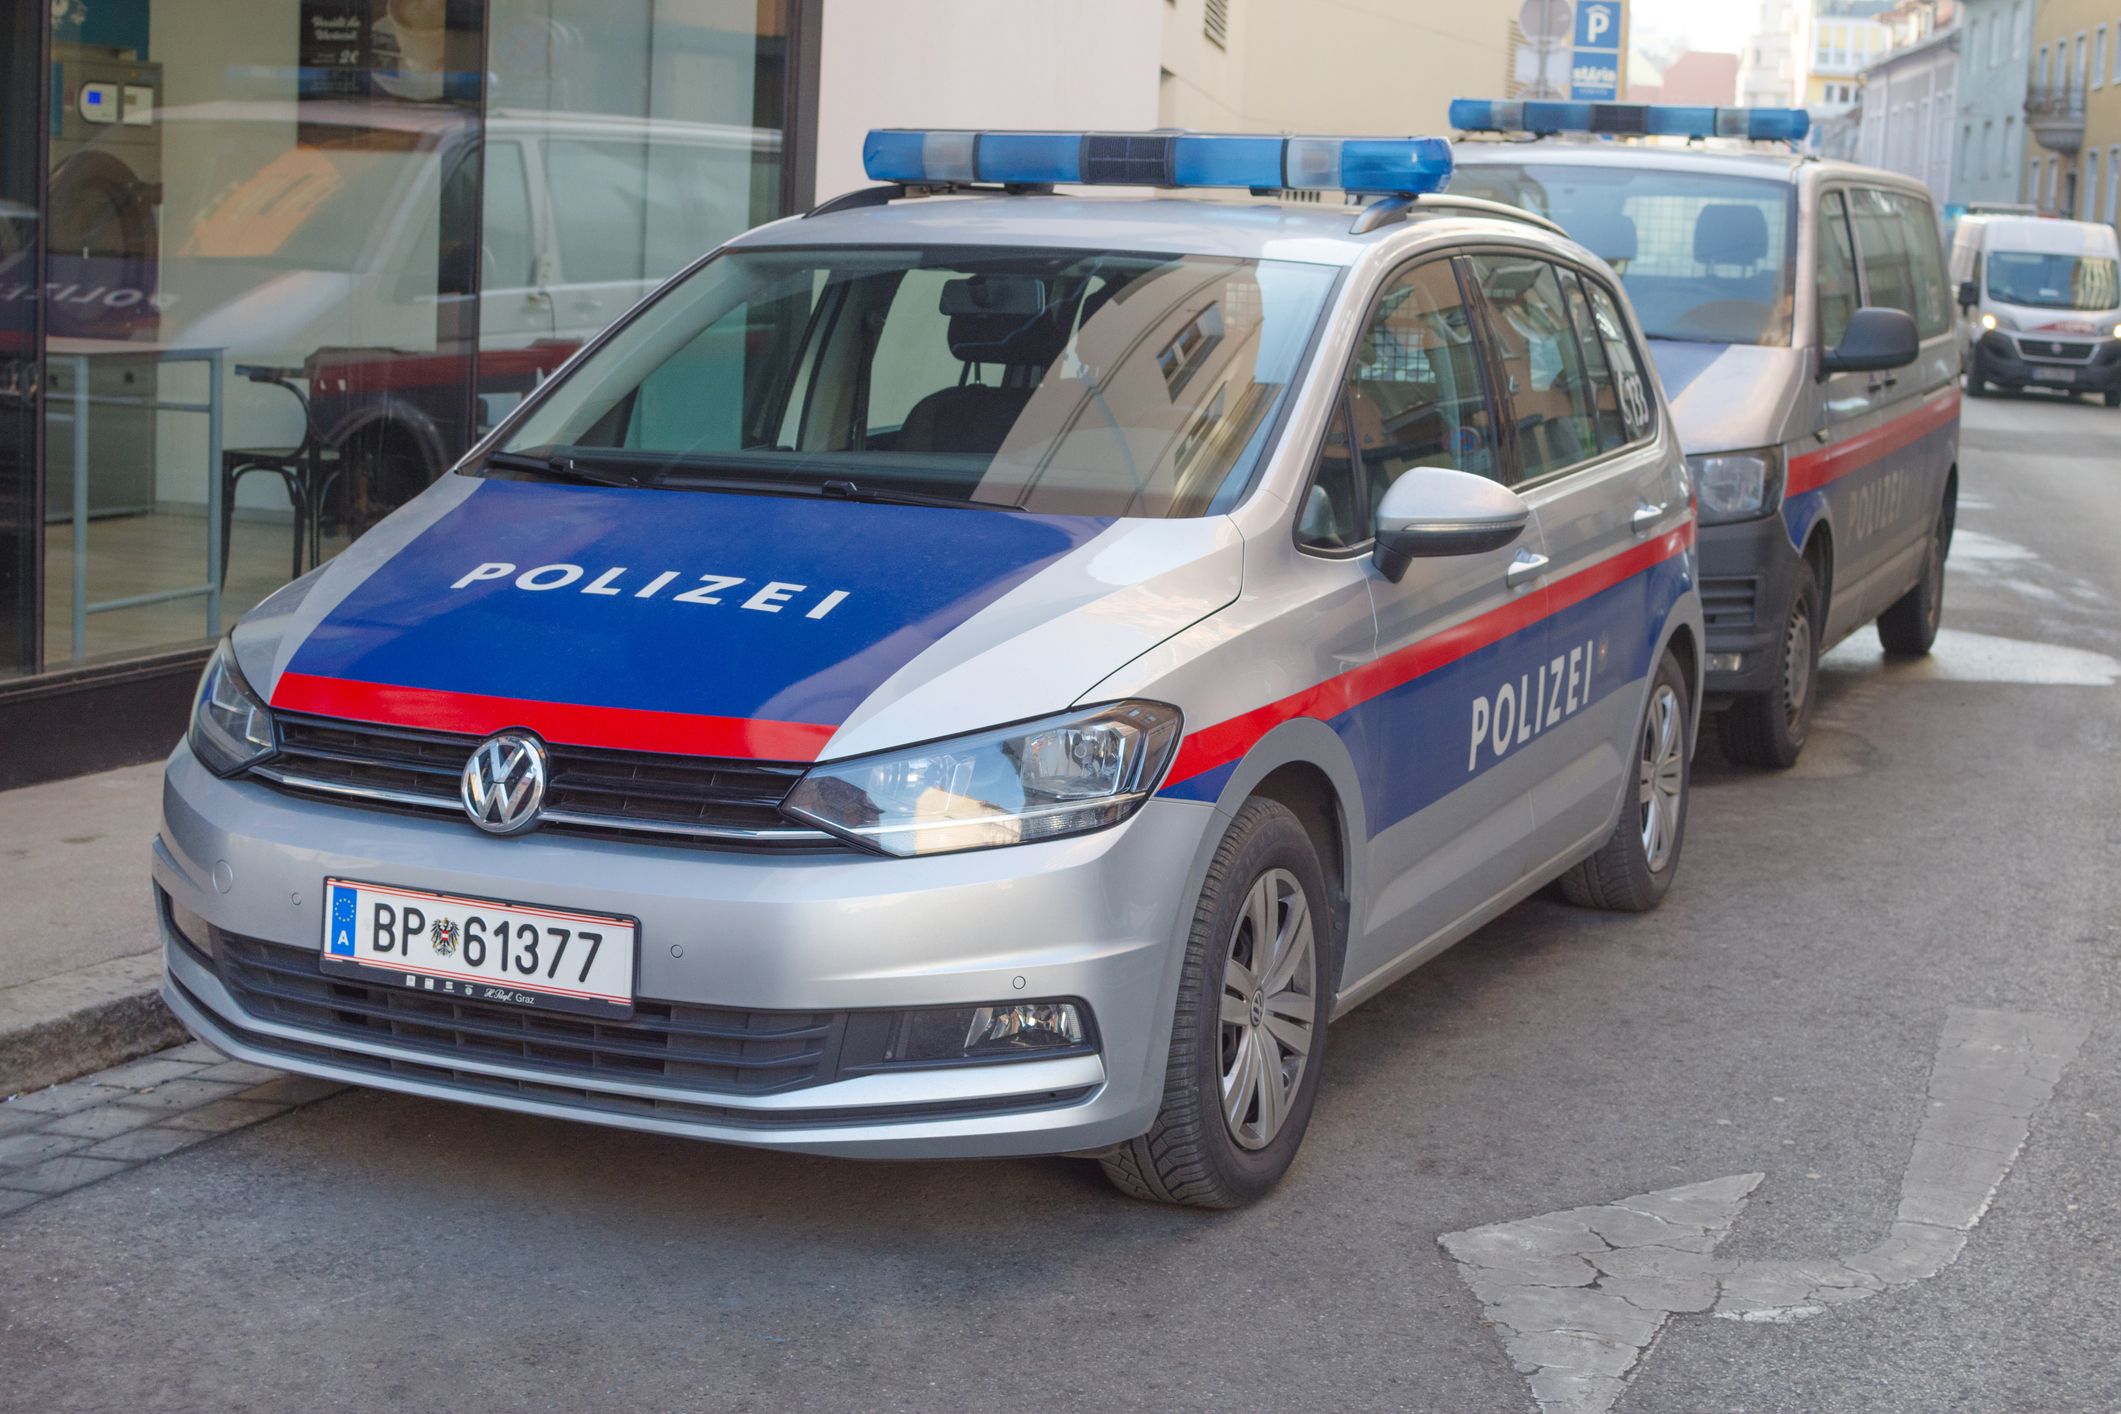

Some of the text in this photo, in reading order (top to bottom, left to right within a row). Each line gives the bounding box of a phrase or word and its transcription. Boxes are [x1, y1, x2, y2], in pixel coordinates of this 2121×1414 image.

[1588, 12, 1610, 43] P
[450, 562, 850, 620] POLIZEI
[1468, 640, 1593, 772] POLIZEI
[337, 902, 603, 983] A BP 61377
[515, 993, 535, 1004] Graz
